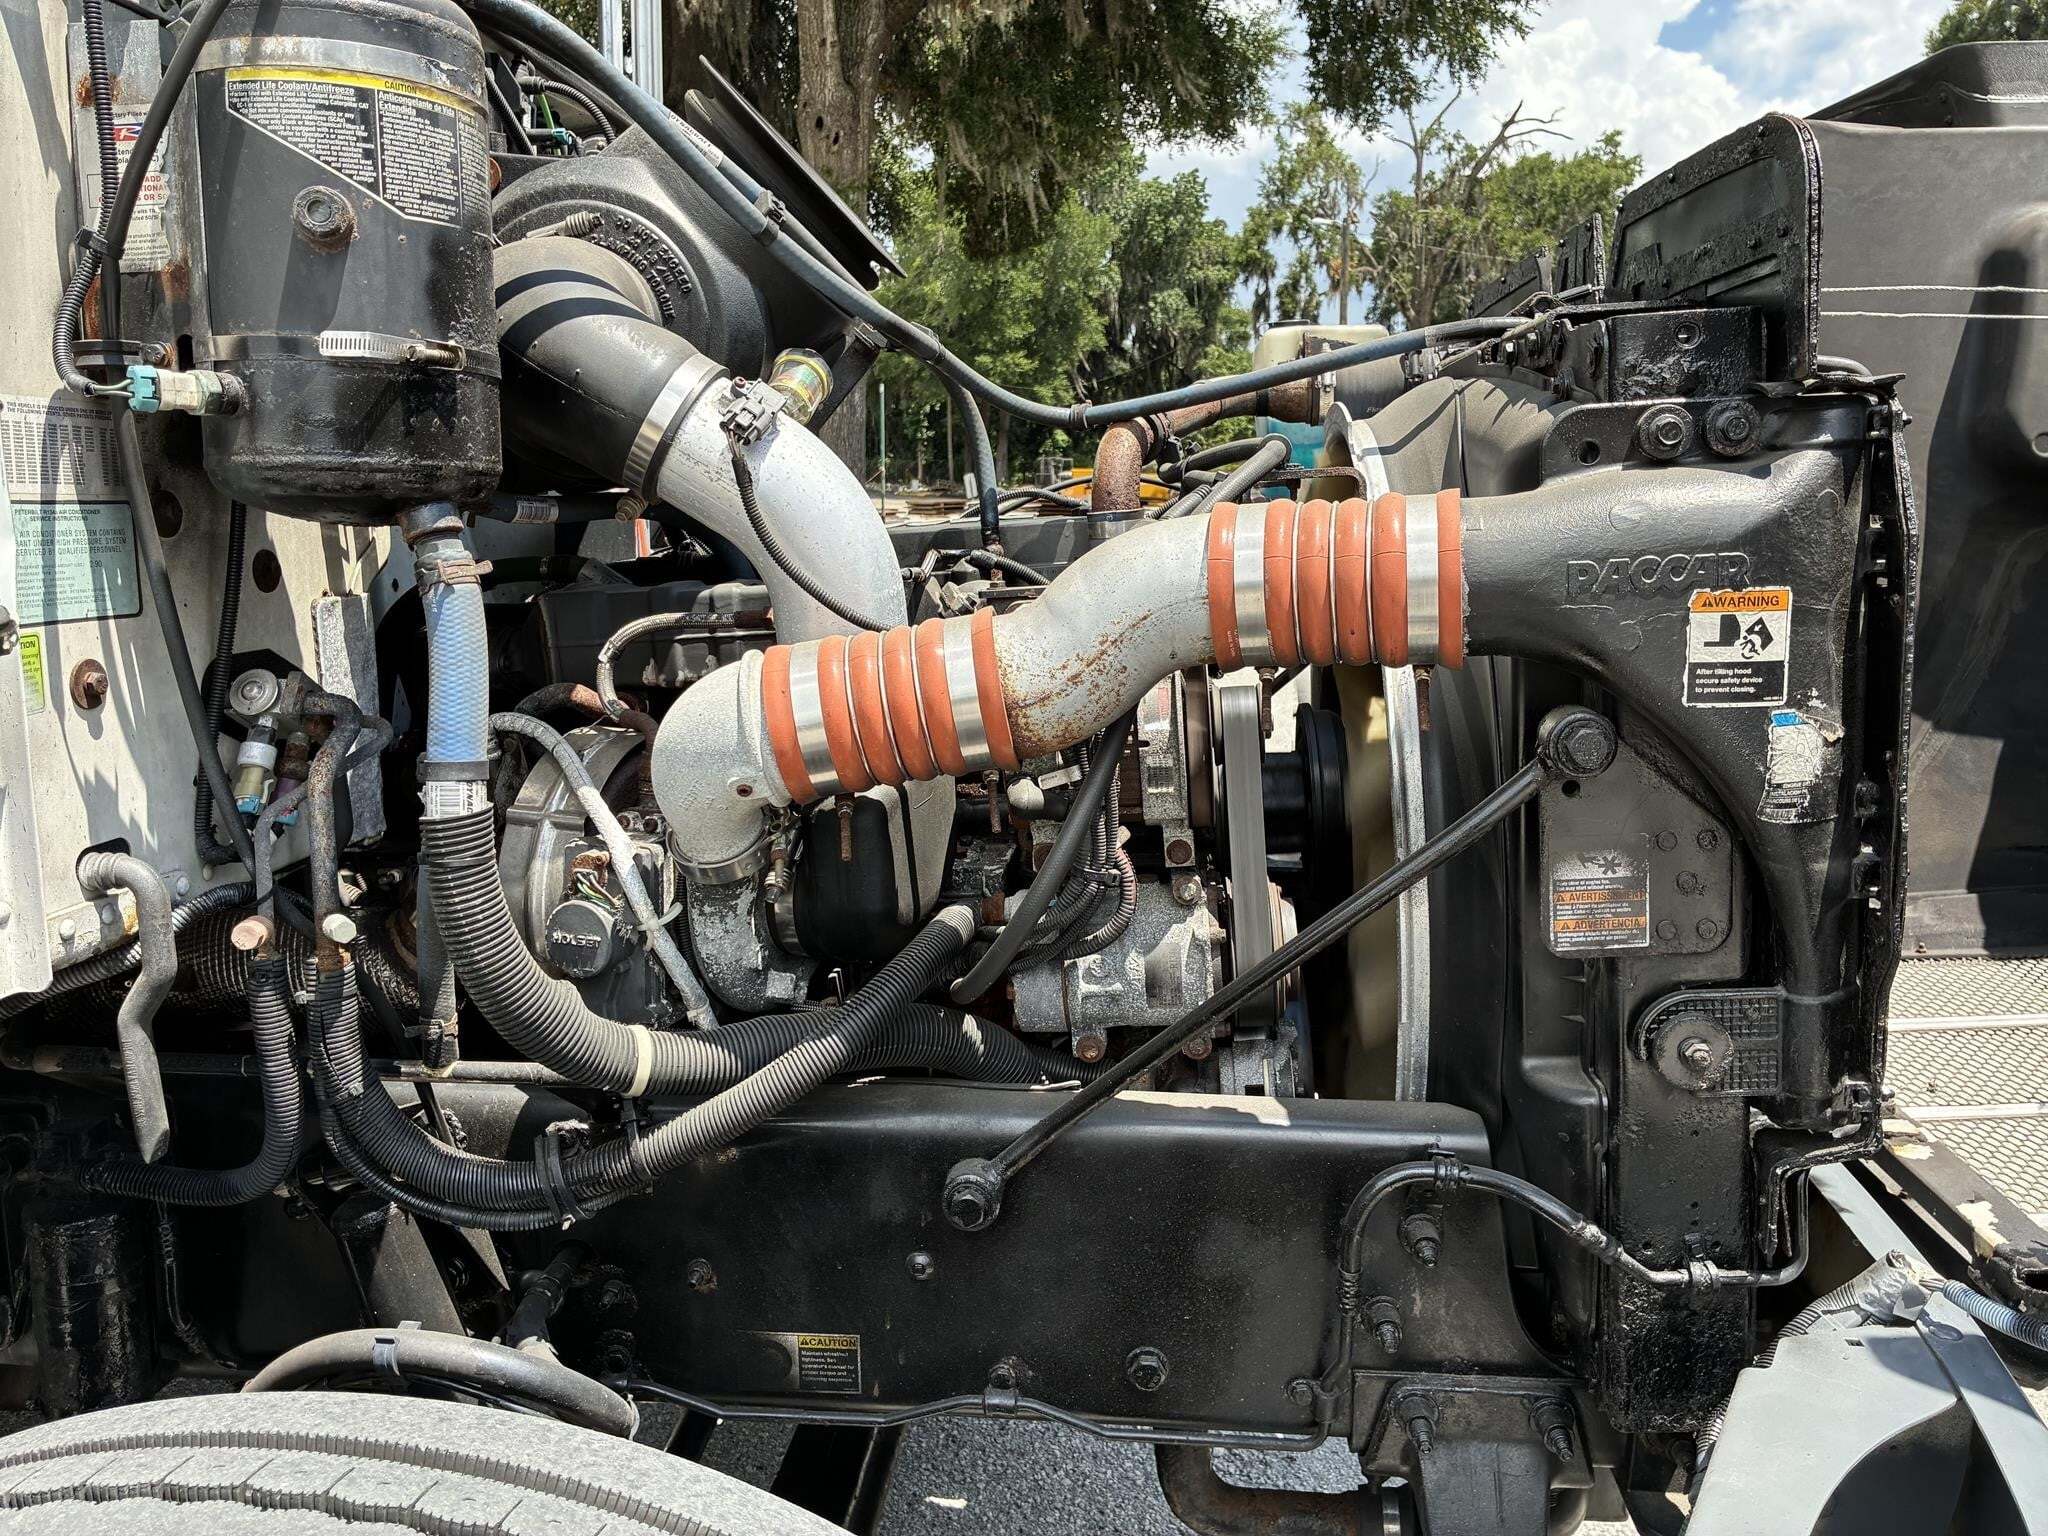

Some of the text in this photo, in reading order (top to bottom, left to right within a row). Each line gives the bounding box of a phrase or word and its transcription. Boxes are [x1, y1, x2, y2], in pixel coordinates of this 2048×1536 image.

[229, 81, 260, 90] Extended
[262, 81, 276, 90] Life
[384, 81, 417, 95] CAUTION
[378, 91, 433, 111] Anticongelante
[378, 101, 417, 117] Extendida
[656, 244, 693, 293] EXCEED
[647, 269, 676, 321] TORQUE
[19, 530, 31, 538] AIR
[32, 529, 73, 538] CONDITIONER
[74, 529, 97, 537] SYSTEM
[72, 537, 102, 546] PRESSURE
[104, 536, 127, 545] SYSTEM
[16, 547, 47, 557] SERVICED
[57, 546, 89, 555] QUALIFIED
[89, 545, 123, 554] PERSONNEL
[1567, 552, 1751, 596] PACCAR
[1712, 595, 1780, 608] WARNING
[1720, 677, 1741, 685] safety
[1703, 686, 1730, 694] prevent
[1730, 686, 1757, 694] closing.
[466, 781, 474, 813] DYNAC
[1573, 917, 1641, 930] ADVERTENCIA
[552, 929, 602, 949] HOLSET
[809, 1338, 857, 1348] CAUTION
